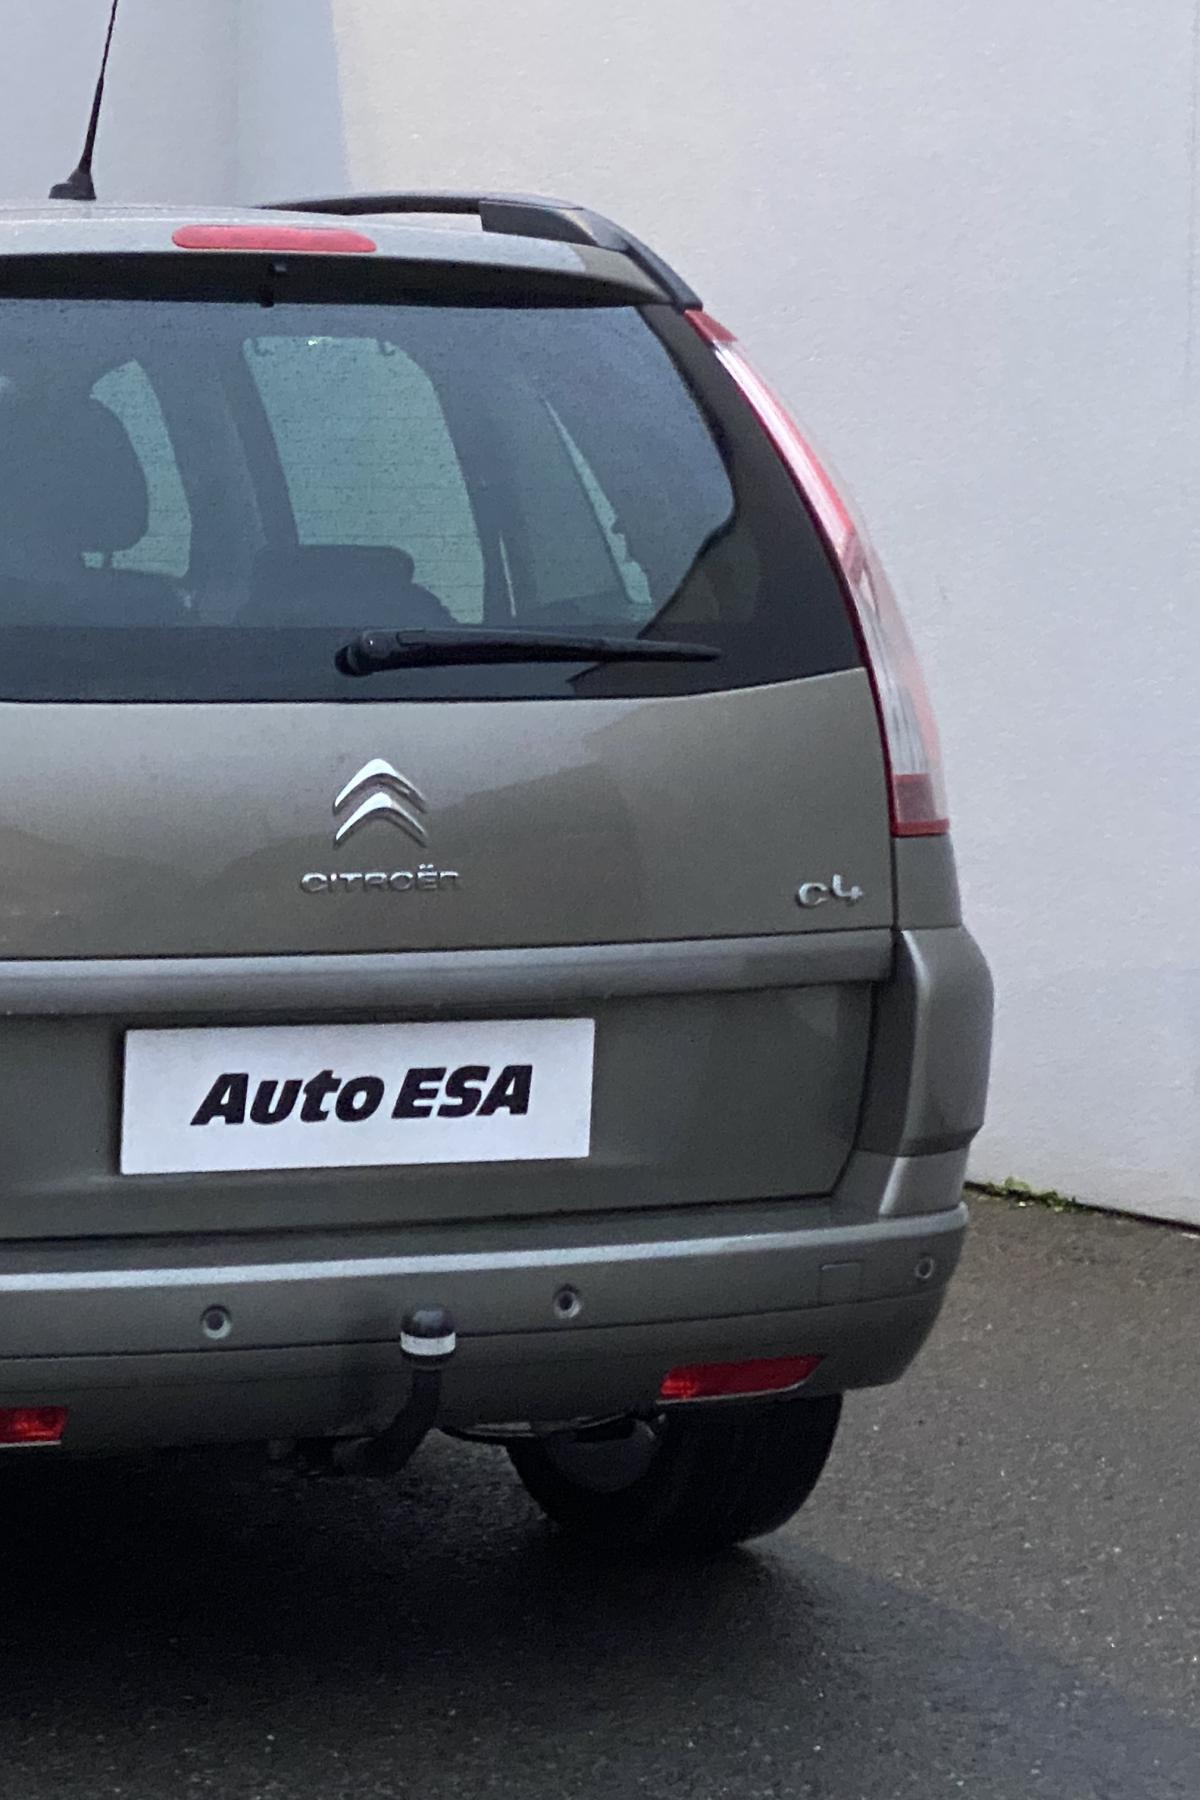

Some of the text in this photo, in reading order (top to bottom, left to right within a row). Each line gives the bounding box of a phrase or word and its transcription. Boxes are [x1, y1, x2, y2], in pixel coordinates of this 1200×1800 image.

[797, 873, 863, 906] C4
[190, 1064, 533, 1126] Auto ESA
